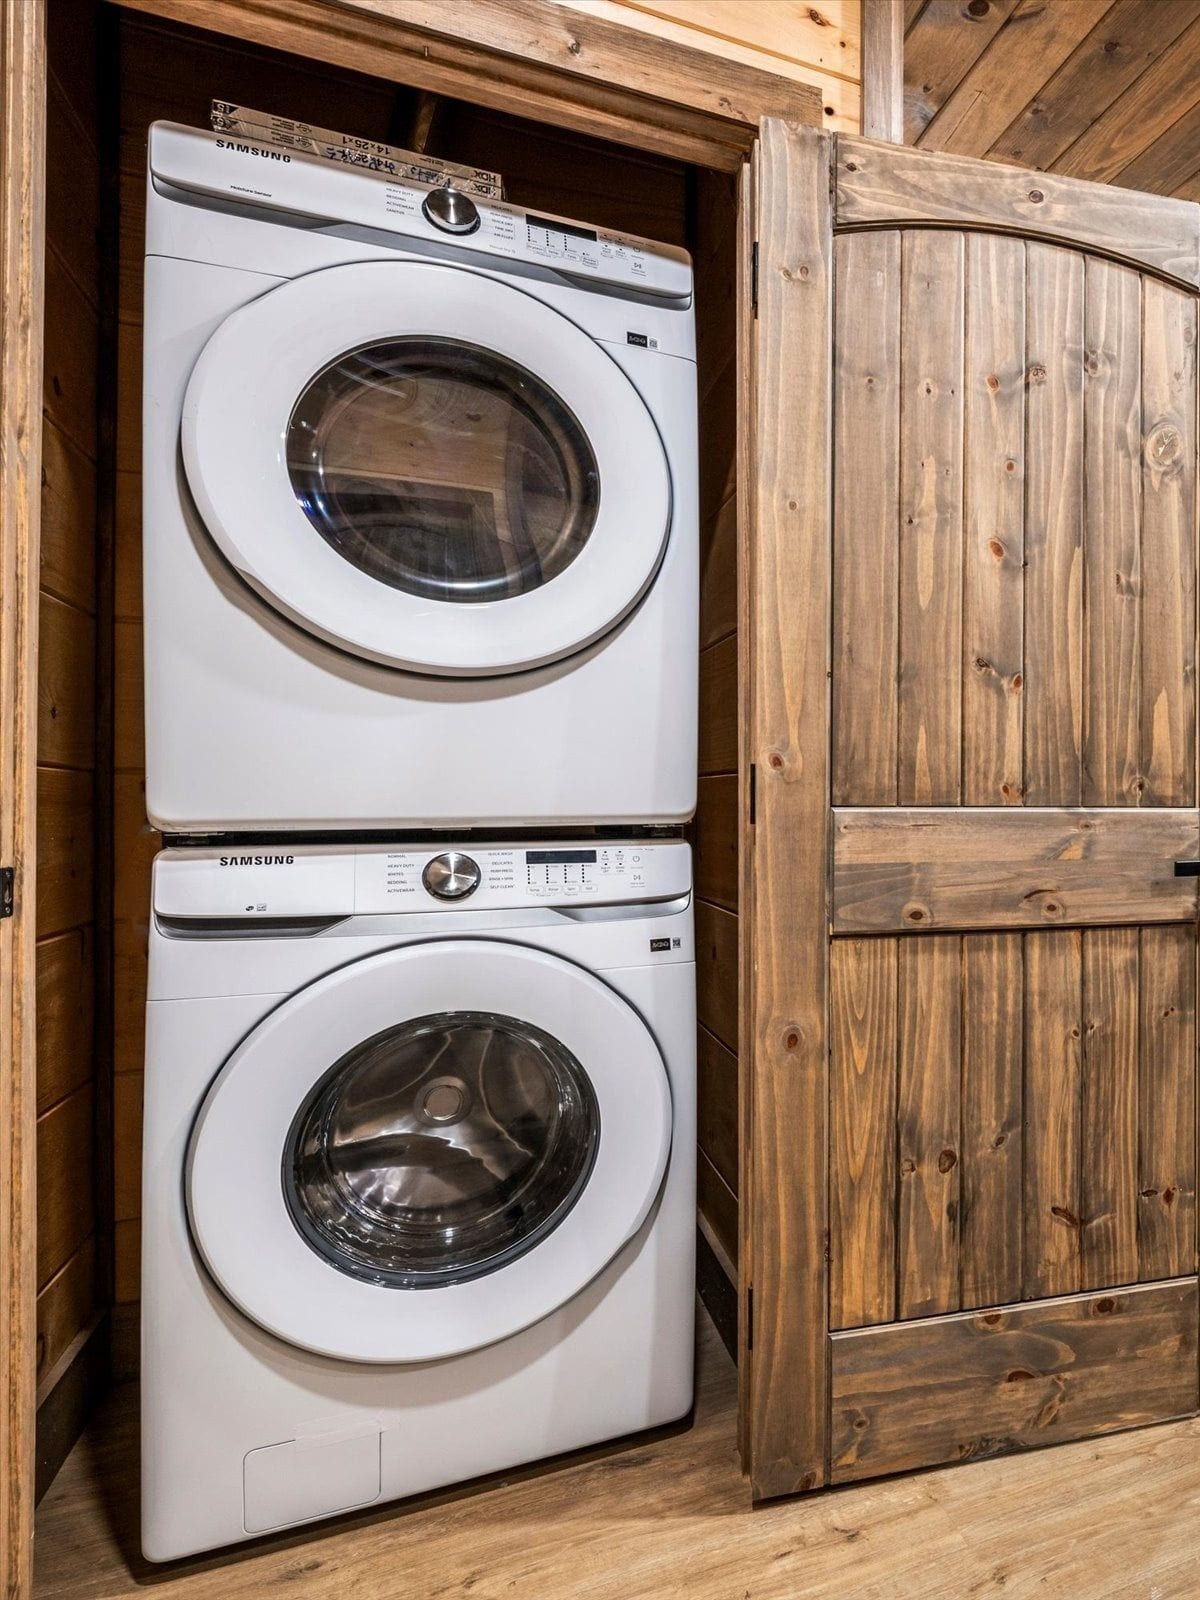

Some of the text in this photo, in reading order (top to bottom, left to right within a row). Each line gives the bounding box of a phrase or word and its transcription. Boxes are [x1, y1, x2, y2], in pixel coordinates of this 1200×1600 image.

[215, 139, 292, 164] SAMSUNG
[473, 169, 497, 184] HDX
[219, 855, 295, 867] SAMSUNG
